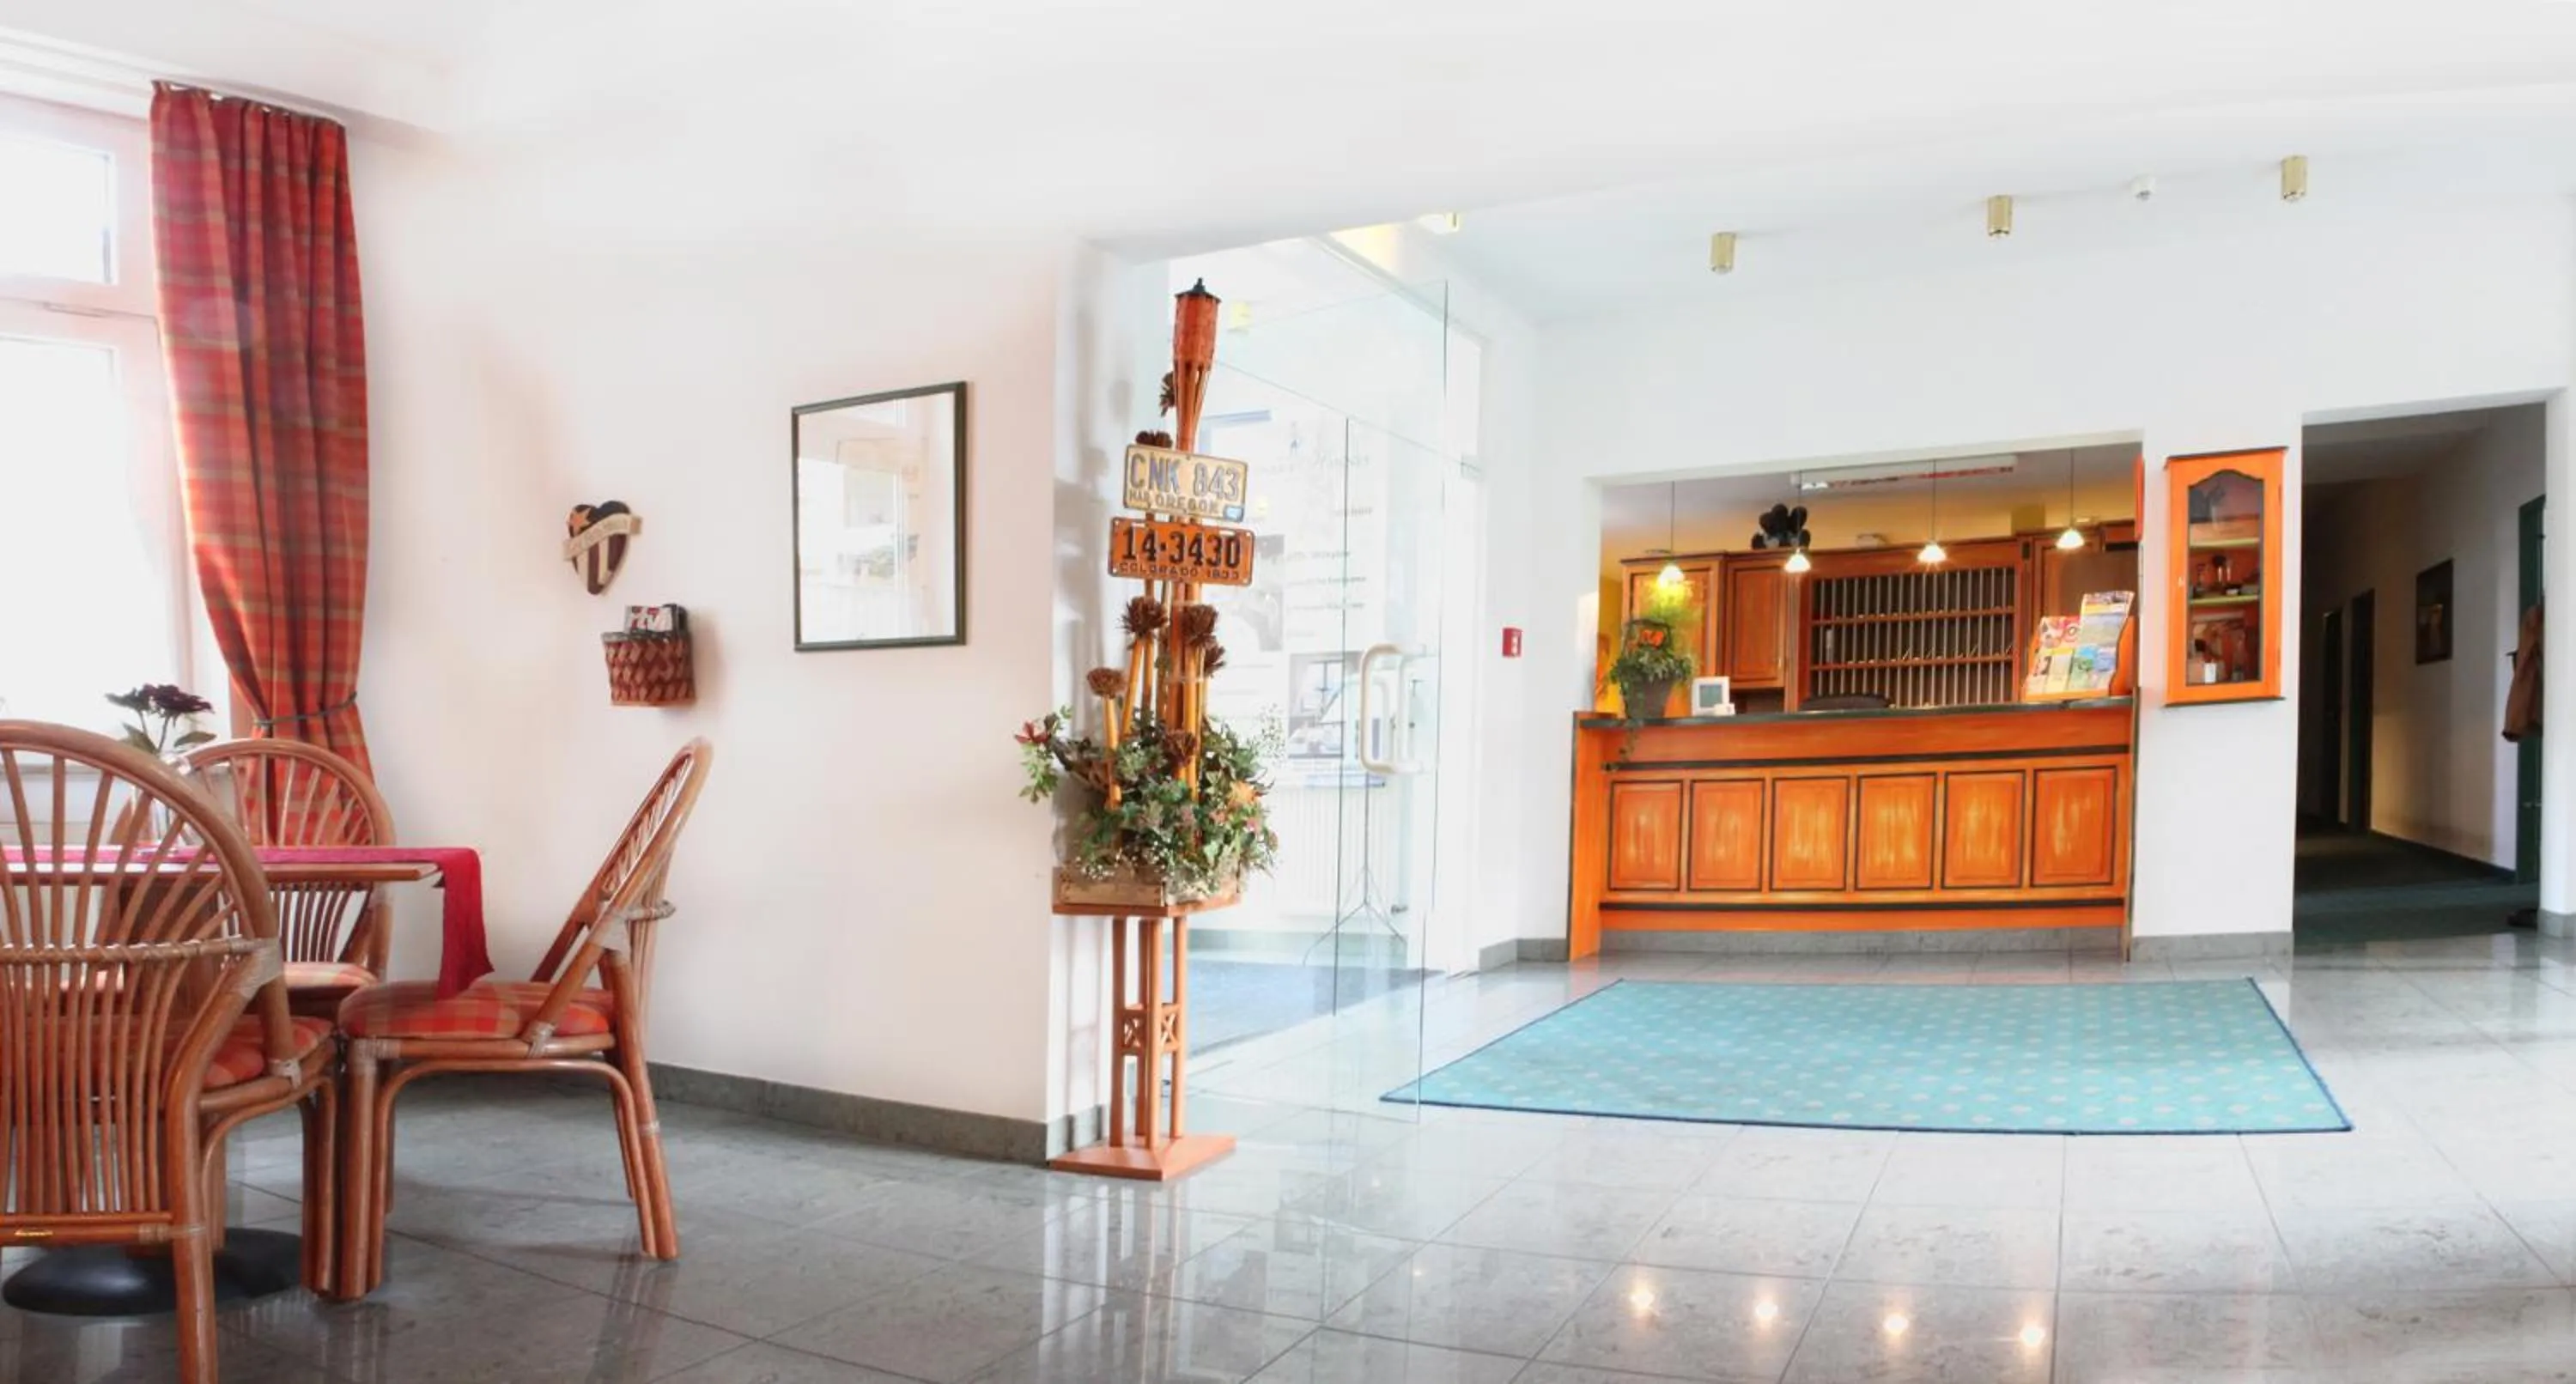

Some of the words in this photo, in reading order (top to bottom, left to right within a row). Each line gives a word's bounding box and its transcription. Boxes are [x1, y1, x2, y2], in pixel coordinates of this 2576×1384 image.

[1131, 452, 1181, 493] CNK
[1194, 462, 1240, 501] 843
[1157, 494, 1219, 513] OREGON
[1120, 562, 1199, 577] COLORADO
